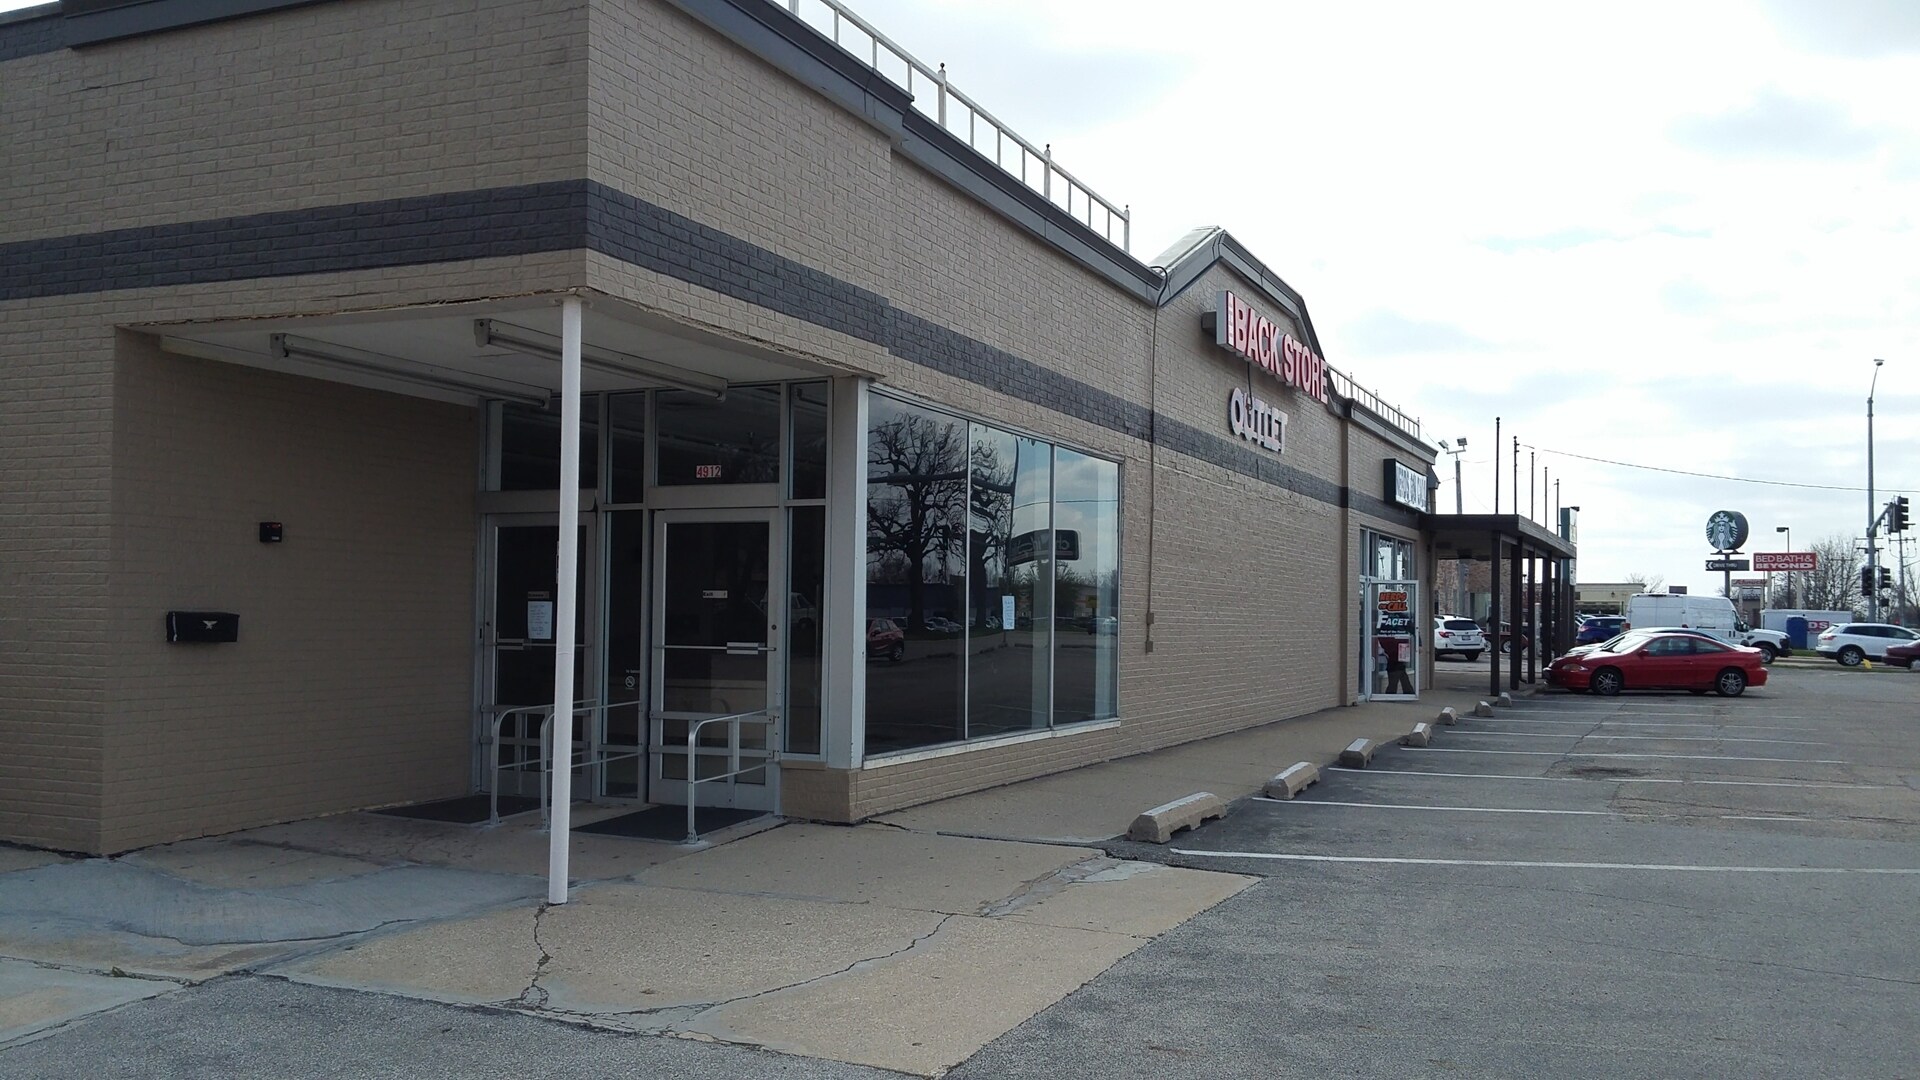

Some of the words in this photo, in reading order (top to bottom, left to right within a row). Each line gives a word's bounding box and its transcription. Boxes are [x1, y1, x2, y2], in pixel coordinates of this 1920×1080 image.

[1234, 296, 1281, 375] BACK
[1282, 333, 1328, 404] STORE
[1230, 387, 1288, 454] OUTLET
[697, 465, 721, 478] 4912
[1387, 602, 1407, 611] CALL
[1376, 614, 1410, 628] FACET
